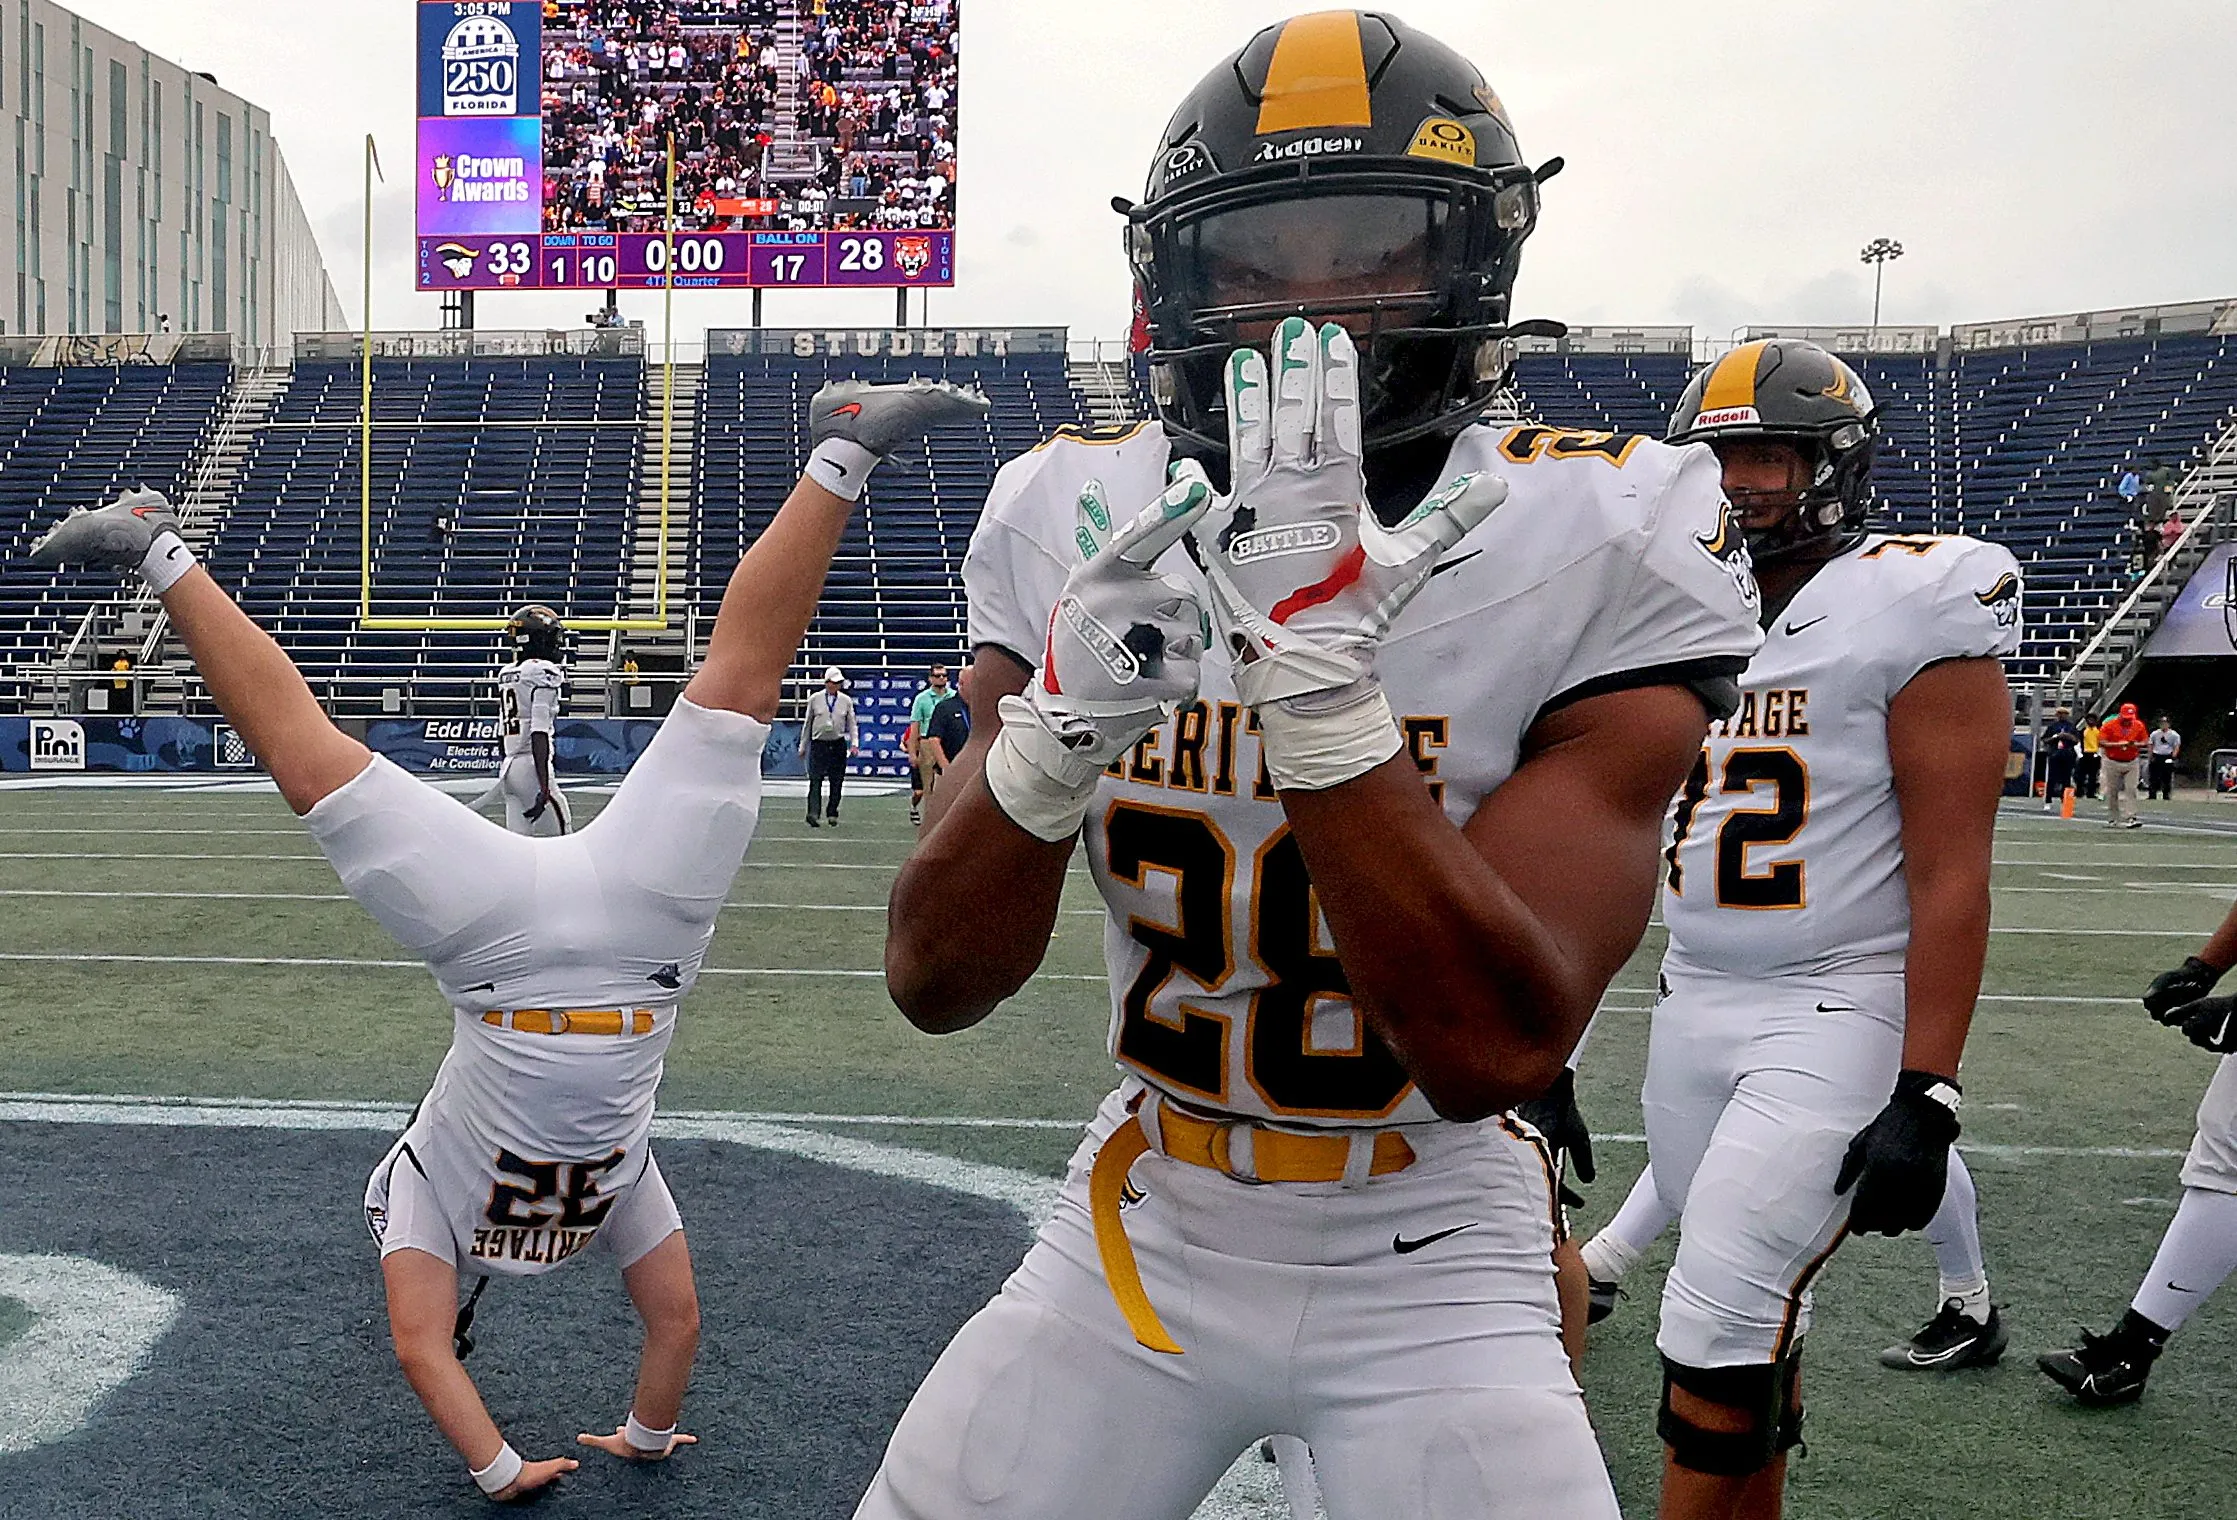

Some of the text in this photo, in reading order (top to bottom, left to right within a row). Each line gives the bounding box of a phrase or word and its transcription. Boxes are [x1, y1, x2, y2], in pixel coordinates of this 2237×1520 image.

[453, 2, 511, 15] 3:05 PM
[462, 47, 499, 56] AMERICA
[447, 61, 514, 93] 250
[452, 100, 508, 110] FLORIDA
[457, 153, 524, 178] Crown
[451, 178, 529, 202] Awards
[544, 235, 576, 246] DOWN
[582, 235, 614, 246] TO GO
[756, 233, 818, 244] BALL ON
[487, 242, 531, 275] 33
[645, 239, 724, 271] 0:00
[839, 238, 884, 271] 28
[422, 272, 431, 285] 2
[551, 257, 565, 283] 1
[581, 256, 615, 283] 10
[771, 255, 805, 281] 17
[674, 275, 721, 287] Quarter
[793, 332, 1012, 357] STUDENT
[1698, 409, 1750, 426] Riddell
[1236, 526, 1330, 558] BATTLE
[1063, 599, 1133, 677] BATTLE
[1718, 688, 1811, 738] AGE
[36, 726, 79, 756] Pini
[424, 722, 463, 738] Edd
[429, 758, 448, 768] Air
[446, 745, 500, 756] Electric &
[1103, 797, 1416, 1119] 28
